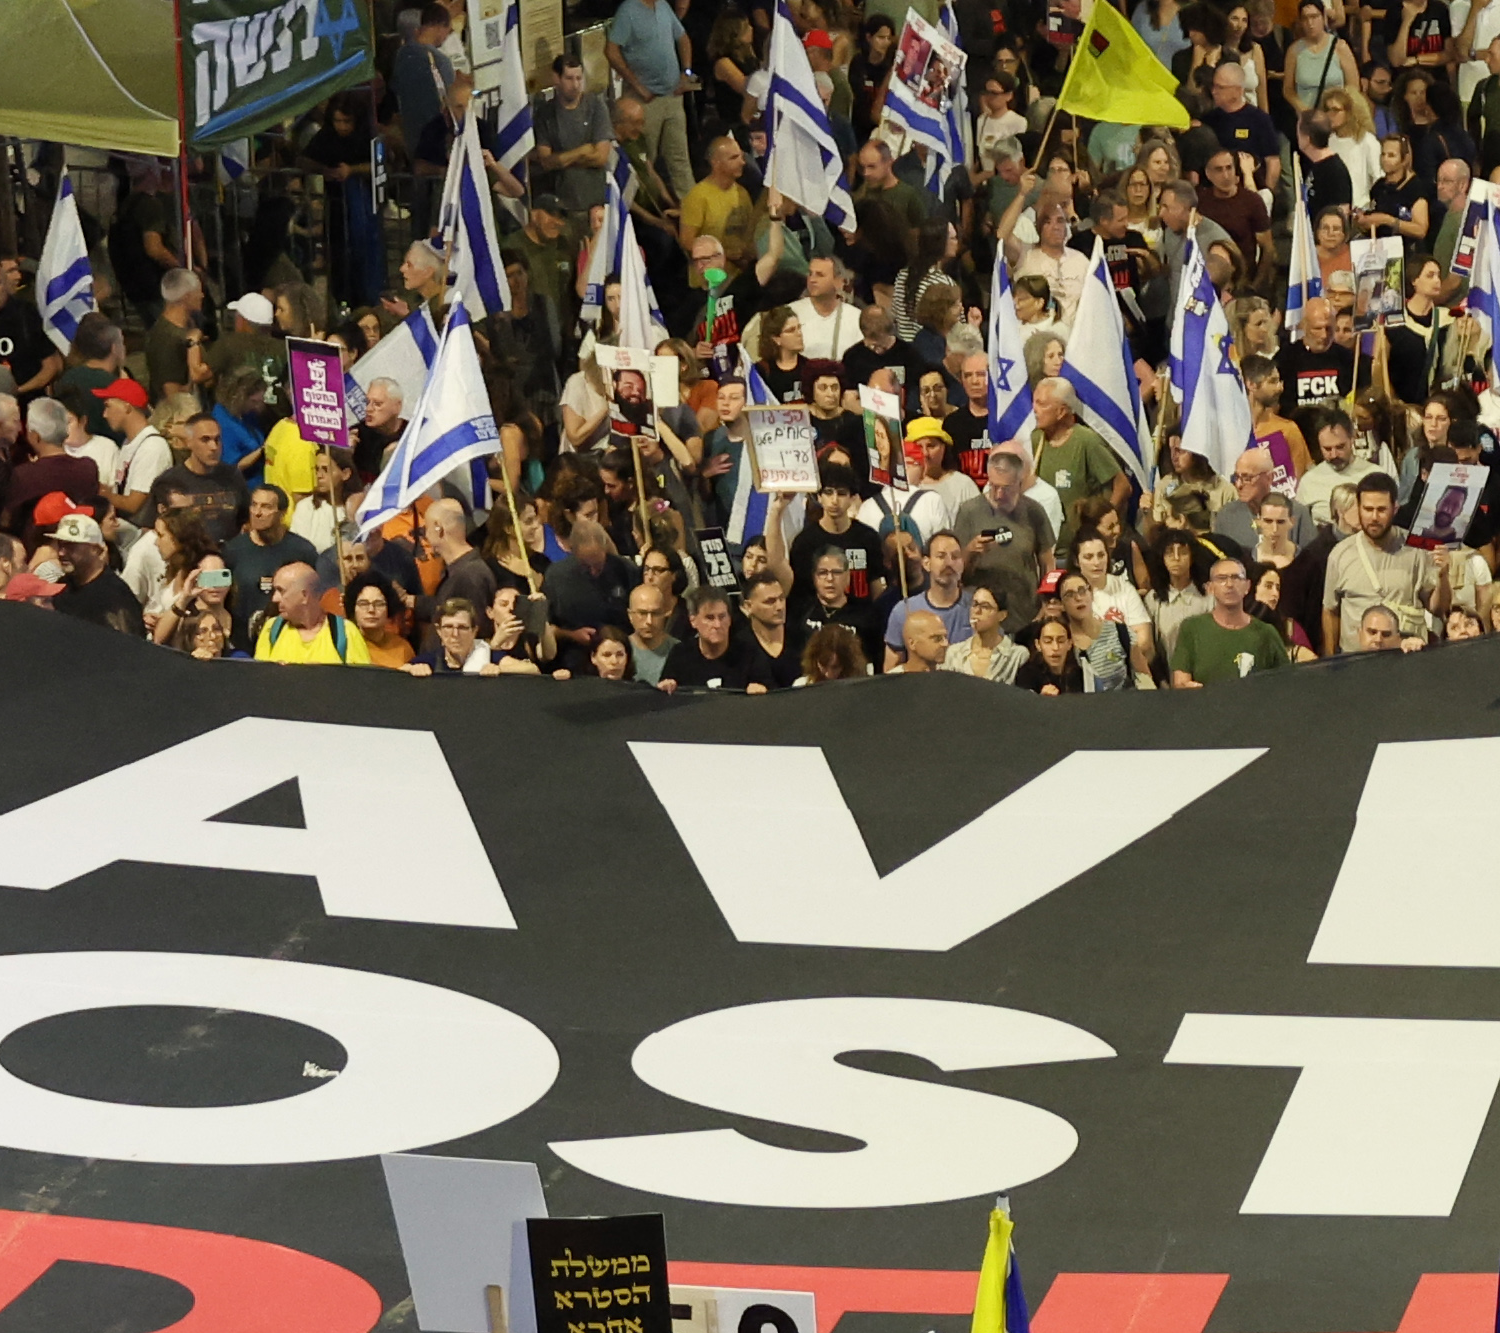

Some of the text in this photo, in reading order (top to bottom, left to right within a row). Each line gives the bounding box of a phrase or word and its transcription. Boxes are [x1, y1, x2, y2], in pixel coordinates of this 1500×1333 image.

[1297, 376, 1340, 397] FCK
[550, 1248, 651, 1278] ממשלת
[553, 1283, 651, 1310] הסטרא
